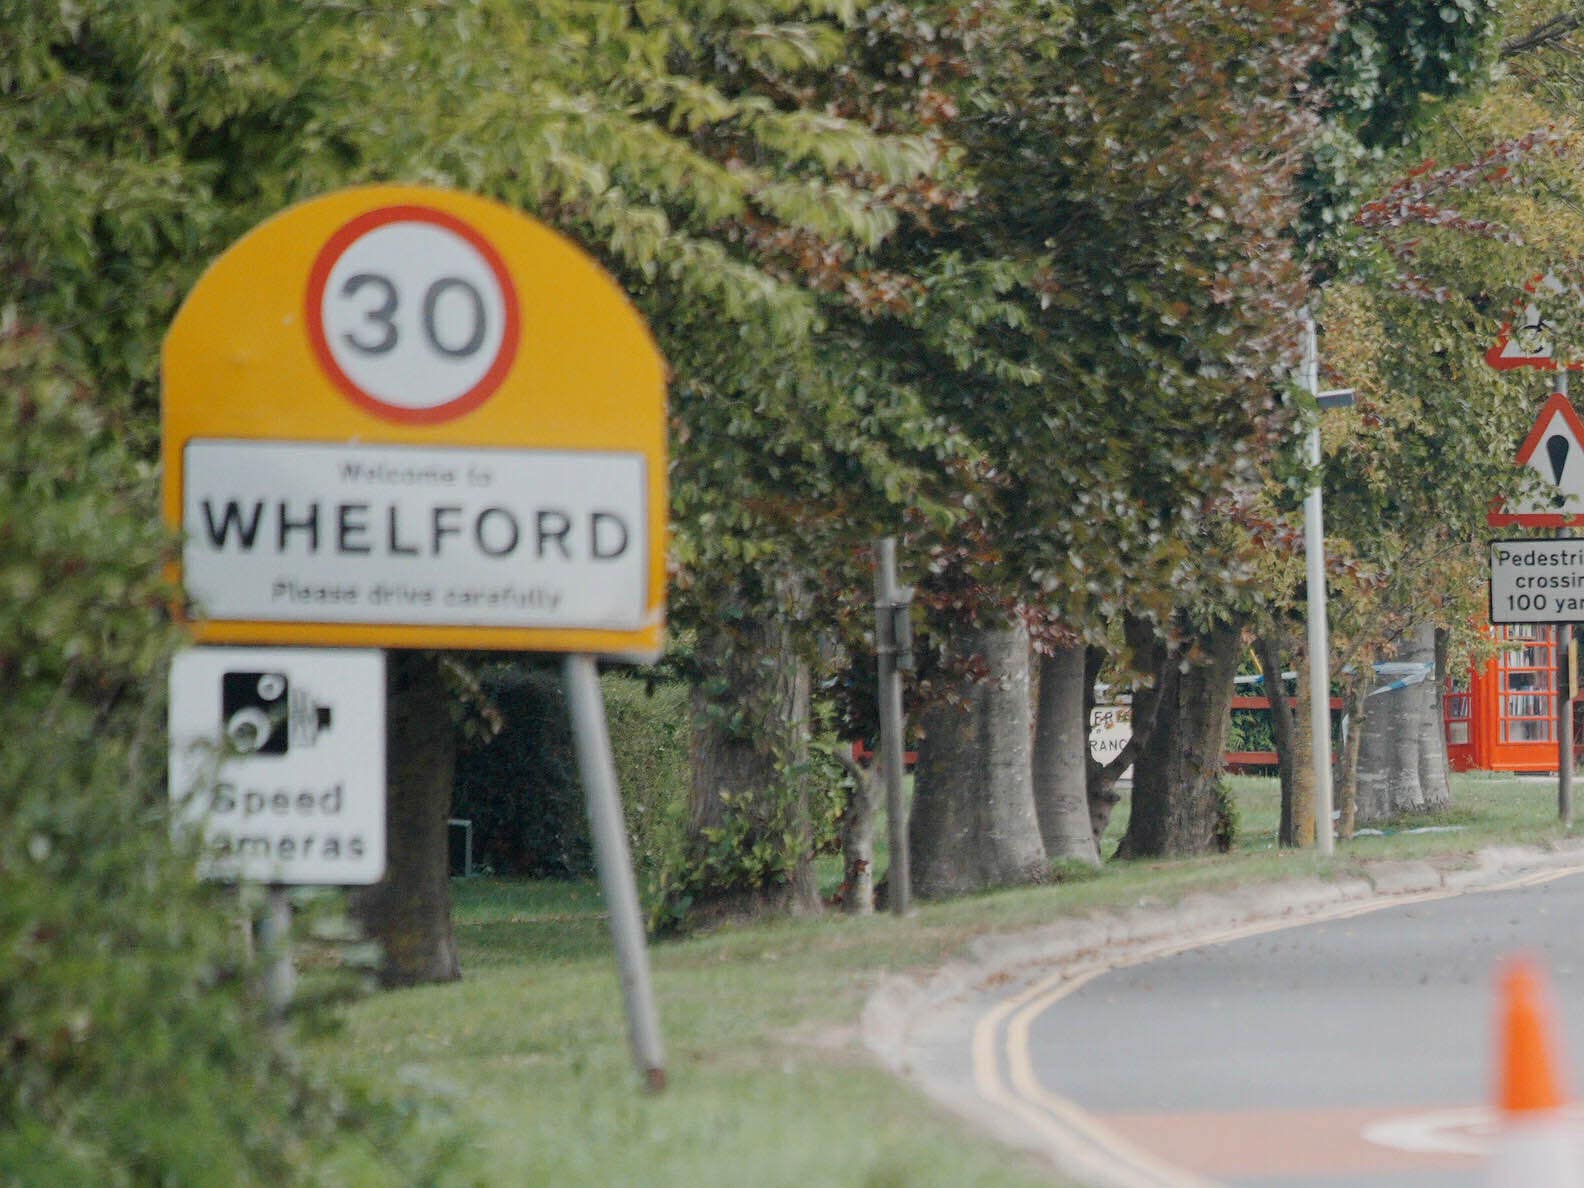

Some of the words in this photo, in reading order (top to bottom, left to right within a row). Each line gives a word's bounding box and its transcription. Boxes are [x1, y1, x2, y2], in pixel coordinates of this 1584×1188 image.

[341, 273, 487, 357] 30
[338, 462, 456, 486] Welcome
[469, 465, 493, 486] to
[202, 498, 629, 559] WHELFORD
[272, 582, 357, 604] Please
[369, 583, 433, 606] drive
[446, 585, 562, 610] carefully
[1508, 595, 1546, 611] 100
[212, 783, 342, 815] Speed
[212, 833, 366, 857] ameras
